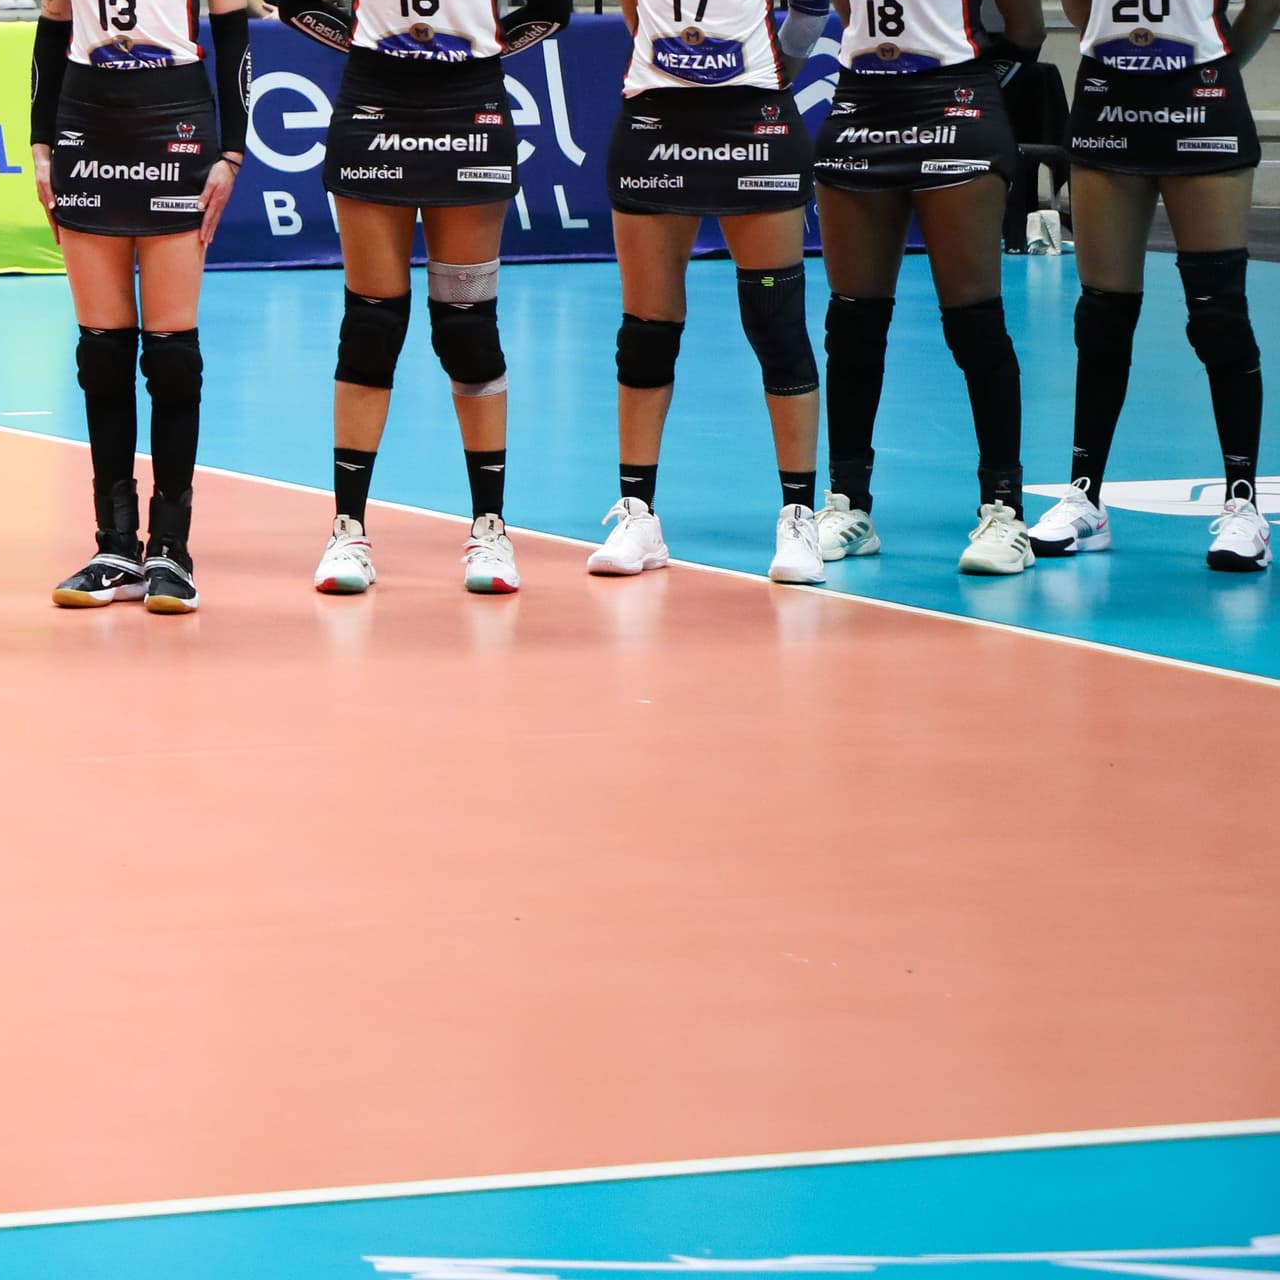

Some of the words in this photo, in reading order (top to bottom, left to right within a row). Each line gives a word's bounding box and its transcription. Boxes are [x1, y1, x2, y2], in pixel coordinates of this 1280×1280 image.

[867, 0, 905, 37] 18
[658, 51, 736, 69] MEZZANI
[1103, 56, 1186, 69] MEZZANI
[478, 114, 501, 124] SESI
[1098, 106, 1206, 123] Mondelli
[757, 126, 786, 134] SESI
[836, 126, 956, 144] Mondelli
[171, 144, 198, 153] SESI
[369, 134, 488, 152] Mondelli
[1072, 135, 1127, 149] Mobifácil
[648, 144, 769, 161] Mondelli
[70, 161, 179, 181] Mondelli
[341, 165, 402, 180] Mobifácil
[621, 174, 682, 188] Mobifácil
[740, 179, 799, 188] PERNAMBUCANAS
[56, 192, 100, 207] obifácil
